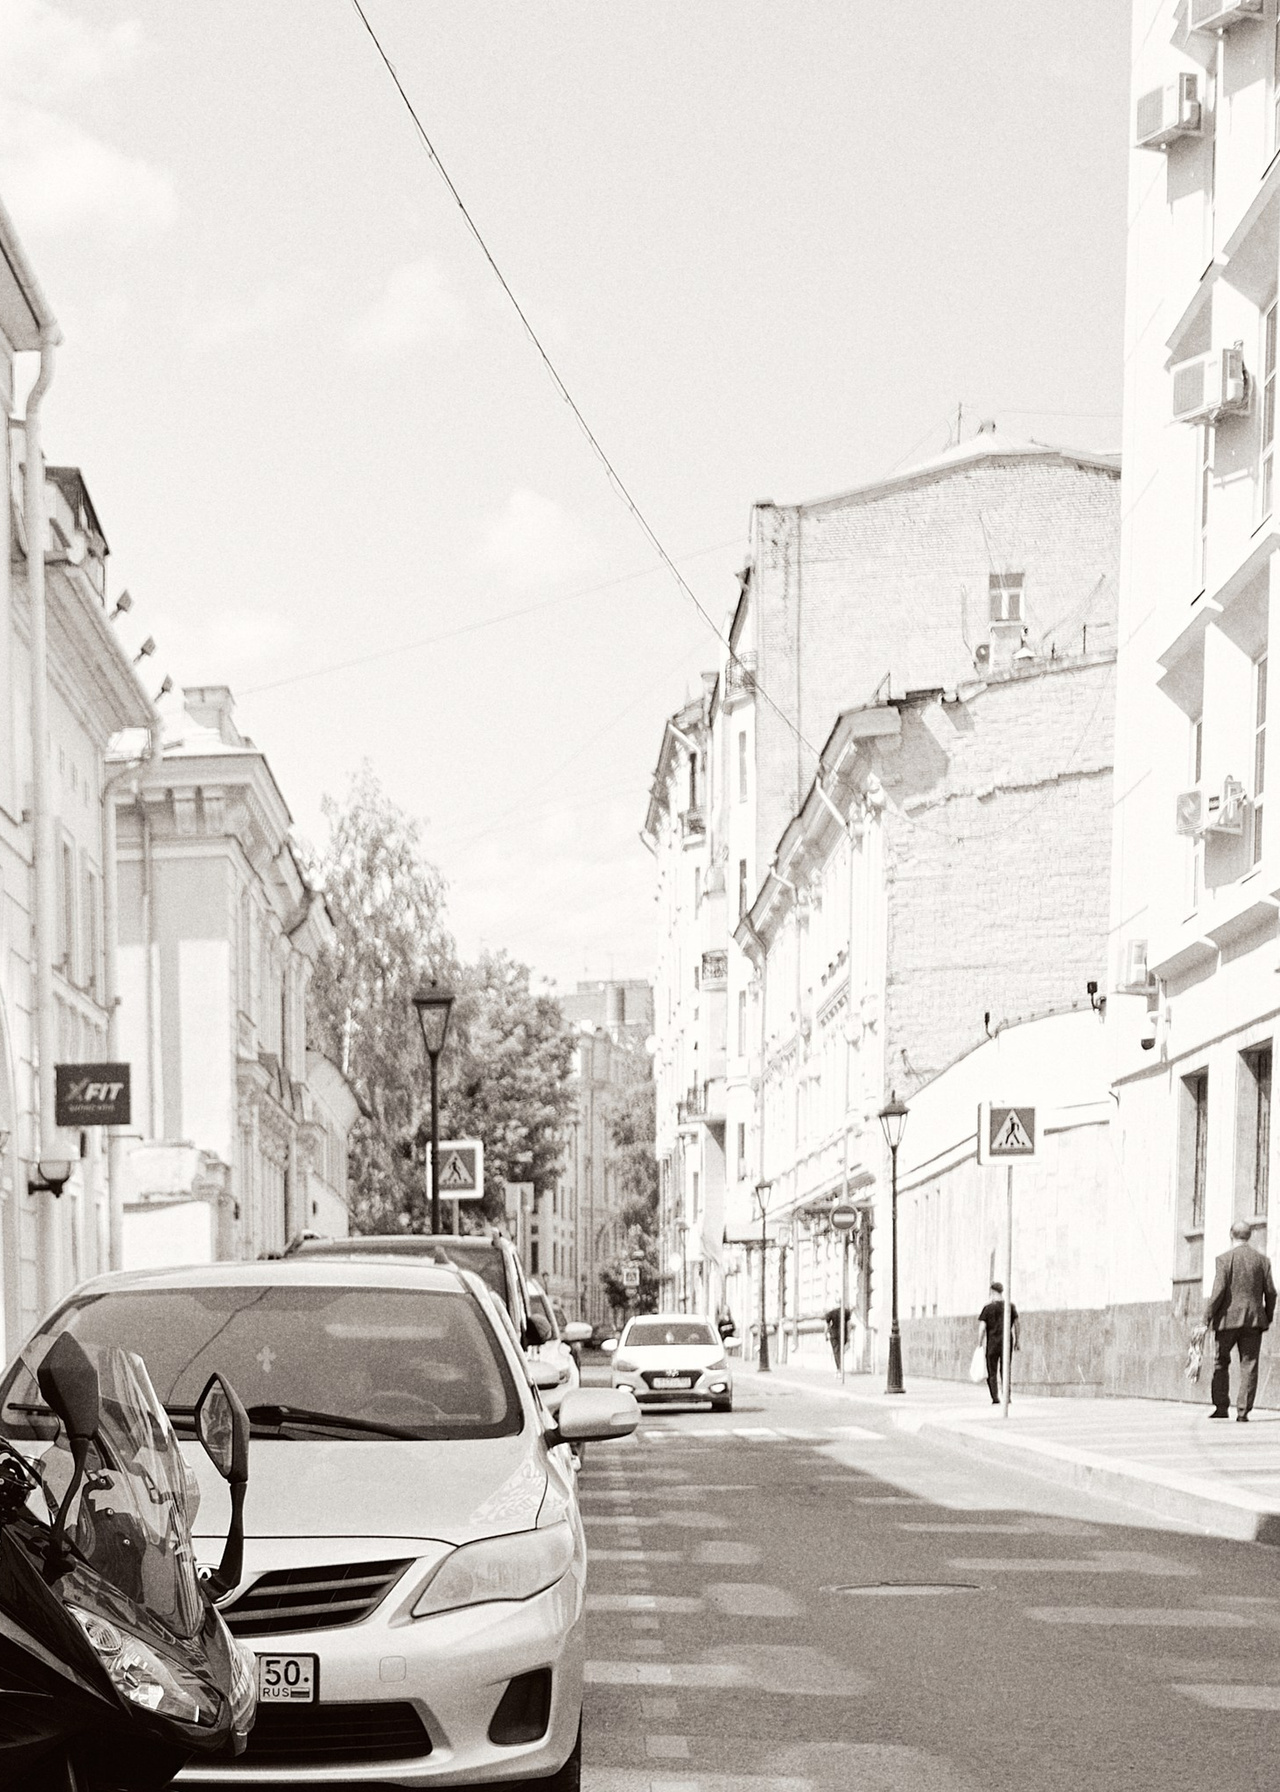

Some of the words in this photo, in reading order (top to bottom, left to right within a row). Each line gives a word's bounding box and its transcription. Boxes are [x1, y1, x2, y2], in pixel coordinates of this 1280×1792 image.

[65, 1077, 124, 1102] XFIT
[264, 1660, 301, 1686] 50
[262, 1687, 290, 1698] RUS
